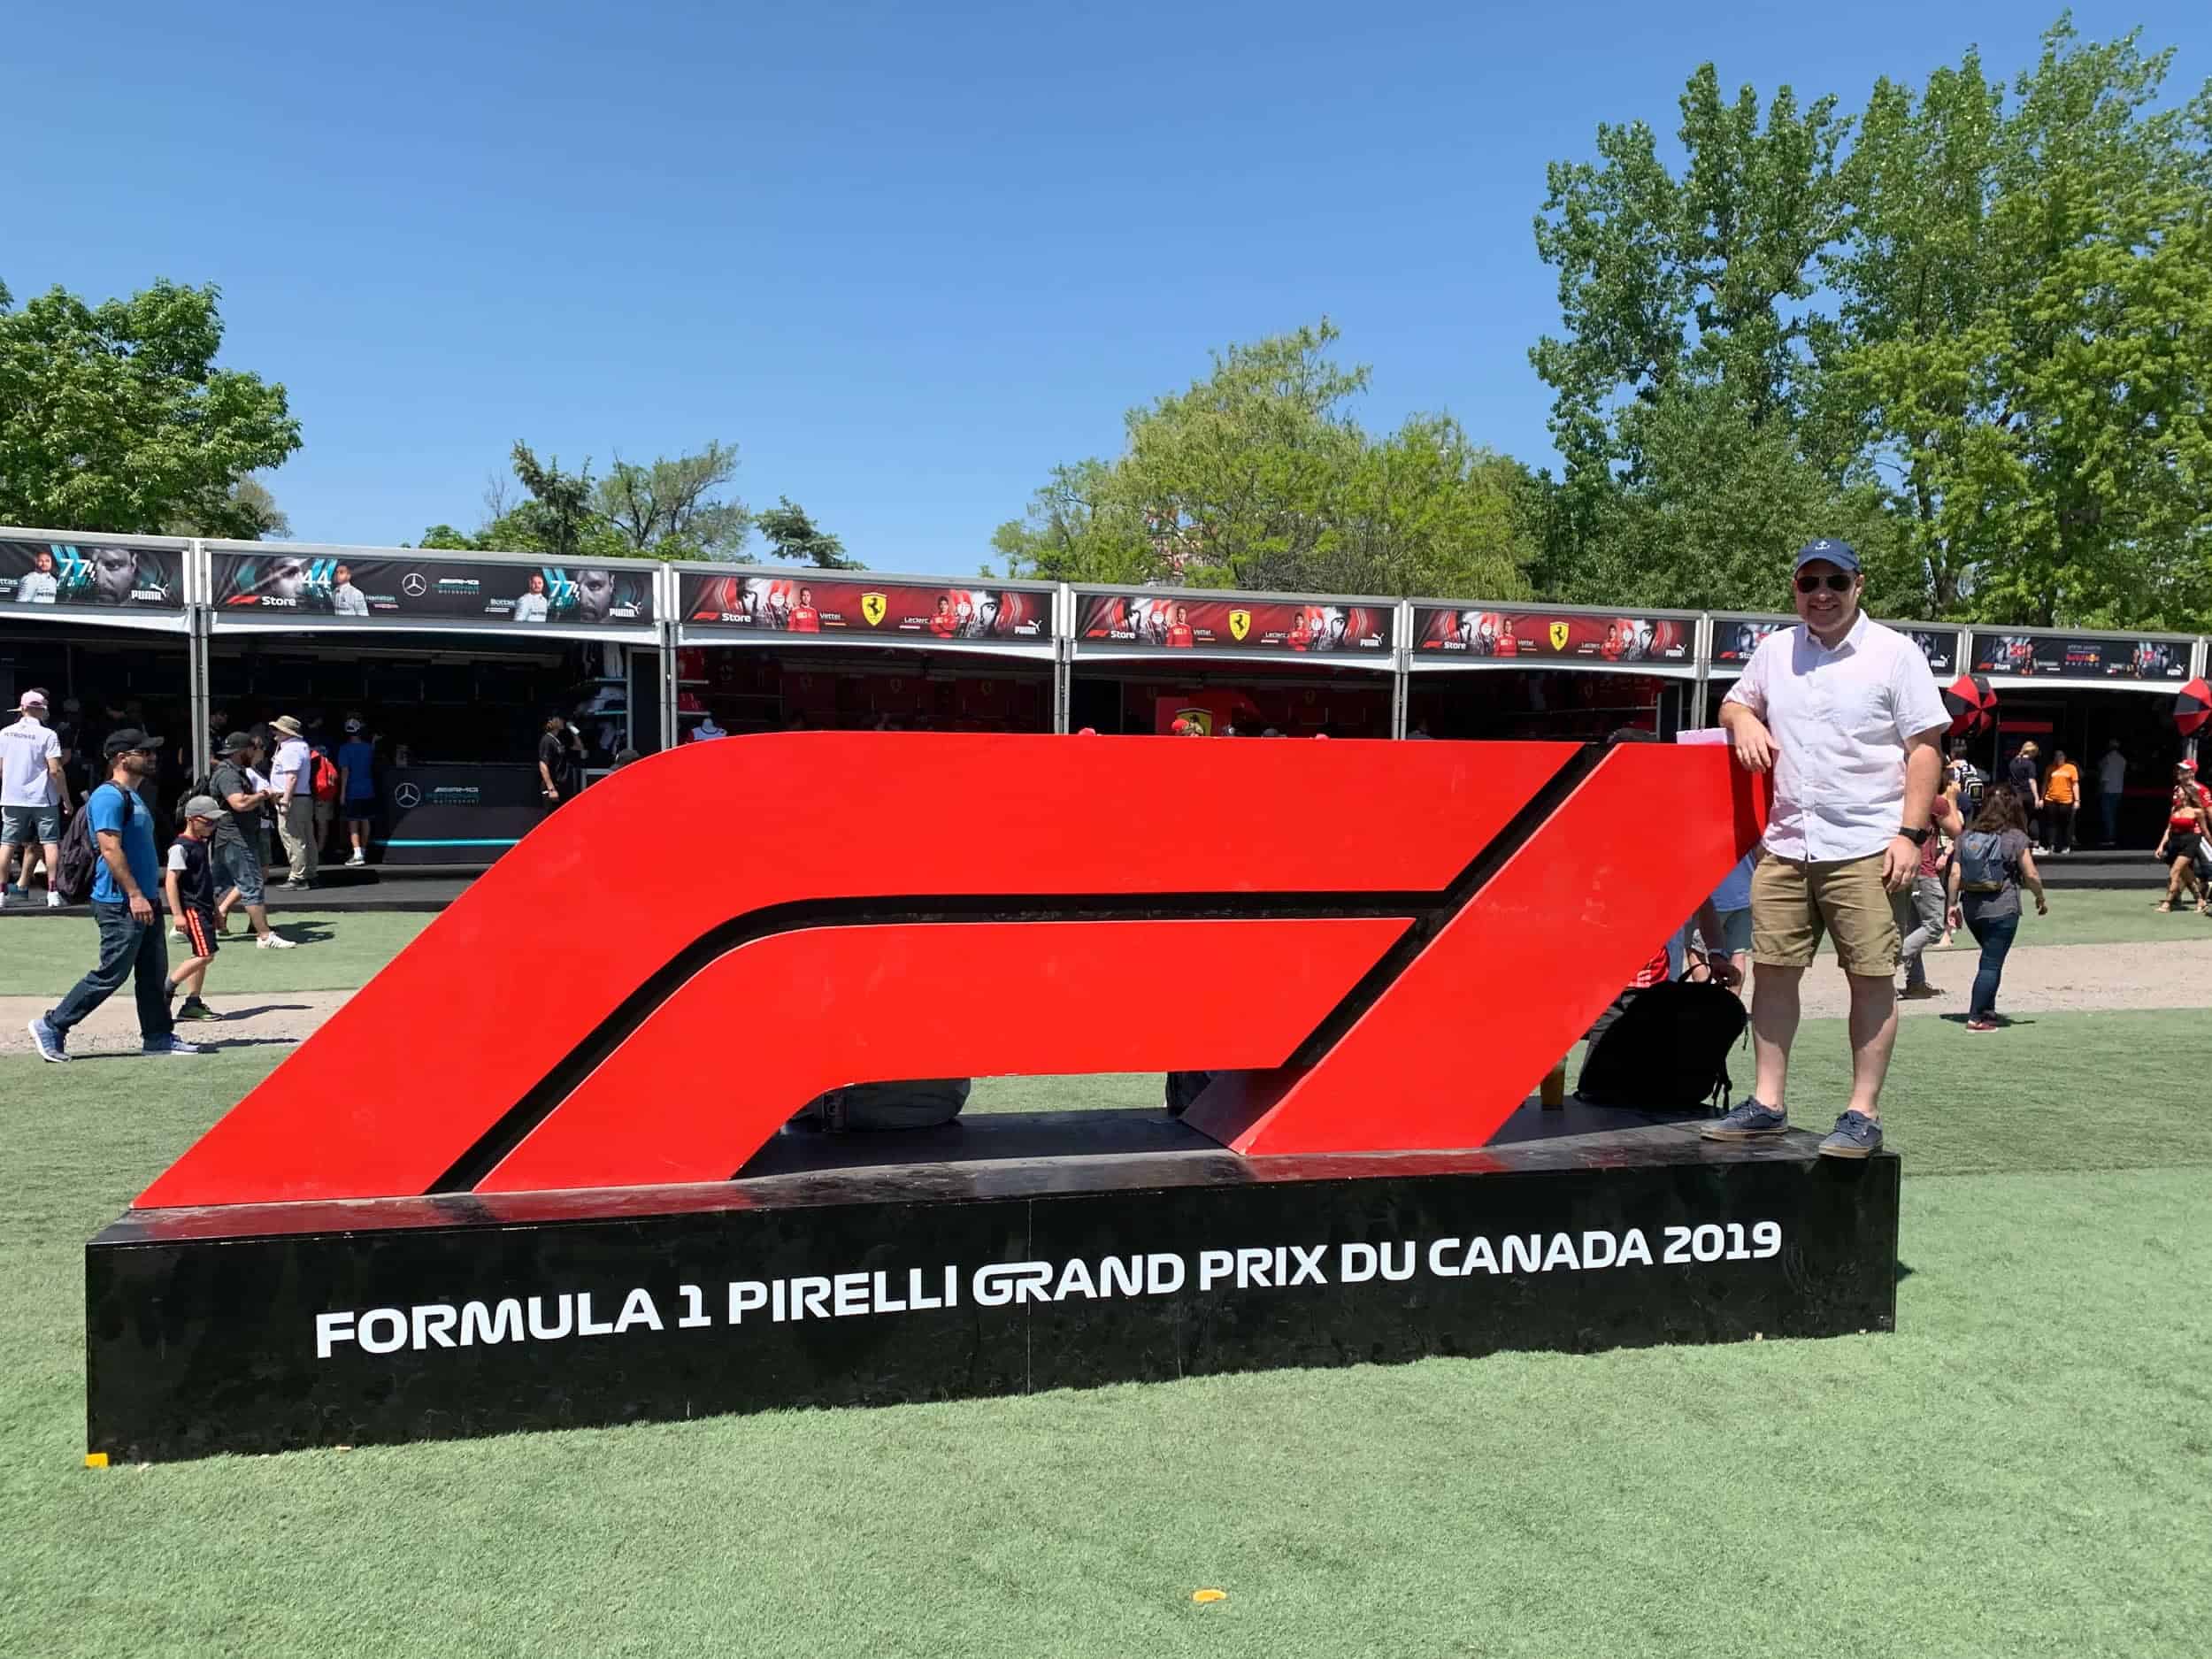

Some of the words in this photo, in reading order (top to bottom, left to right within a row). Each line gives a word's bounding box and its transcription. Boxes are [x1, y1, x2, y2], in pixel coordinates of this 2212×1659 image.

[303, 569, 332, 588] 44
[131, 589, 161, 601] PUMA
[262, 595, 296, 607] Store
[609, 607, 635, 618] PUMA
[721, 612, 751, 623] Store
[1110, 630, 1136, 639] Store
[1443, 641, 1466, 649] Store
[317, 1288, 664, 1357] FORMULA
[680, 1286, 710, 1327] 1
[729, 1266, 957, 1324] PIRELLI
[973, 1254, 1186, 1305] GRAND
[1201, 1246, 1327, 1290] PRIX
[1341, 1241, 1416, 1282] DU
[1430, 1229, 1653, 1276] CANADA
[1663, 1222, 1782, 1263] 2019
